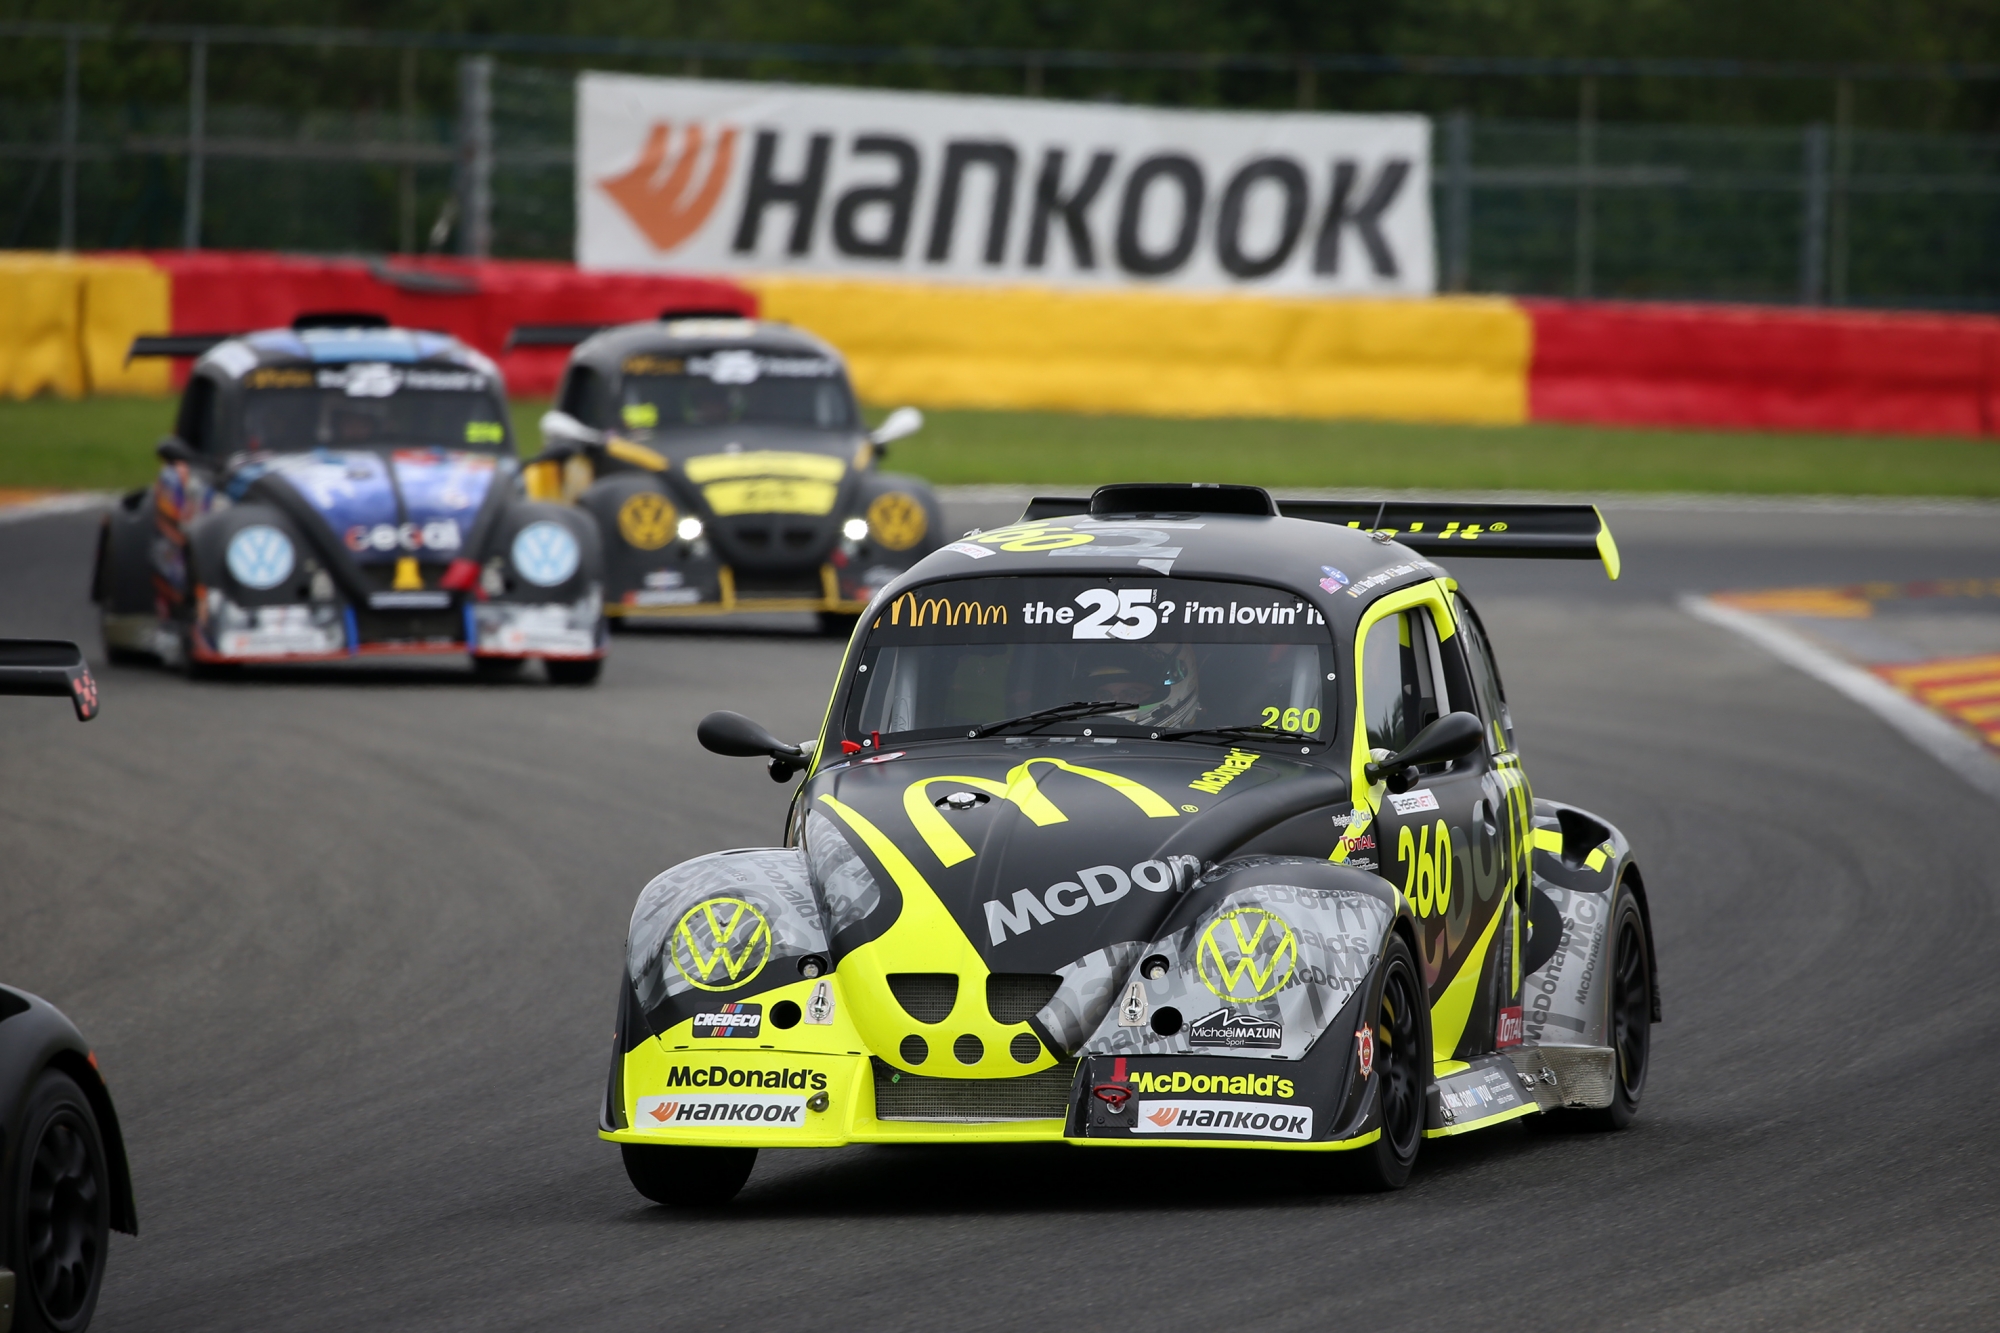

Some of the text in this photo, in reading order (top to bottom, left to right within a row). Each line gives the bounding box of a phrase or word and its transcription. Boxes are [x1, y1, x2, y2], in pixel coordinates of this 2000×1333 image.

[1022, 601, 1075, 625] the
[1184, 602, 1224, 624] i'm
[1229, 602, 1302, 625] lovin'
[1261, 706, 1321, 733] 260
[1339, 834, 1376, 852] TOTAL
[1398, 819, 1452, 919] 260
[1573, 921, 1604, 1005] McDonald's
[693, 1013, 761, 1027] CREDECO
[1225, 1038, 1245, 1046] Sport
[666, 1066, 827, 1090] McDonald's
[1129, 1071, 1295, 1099] McDonald's
